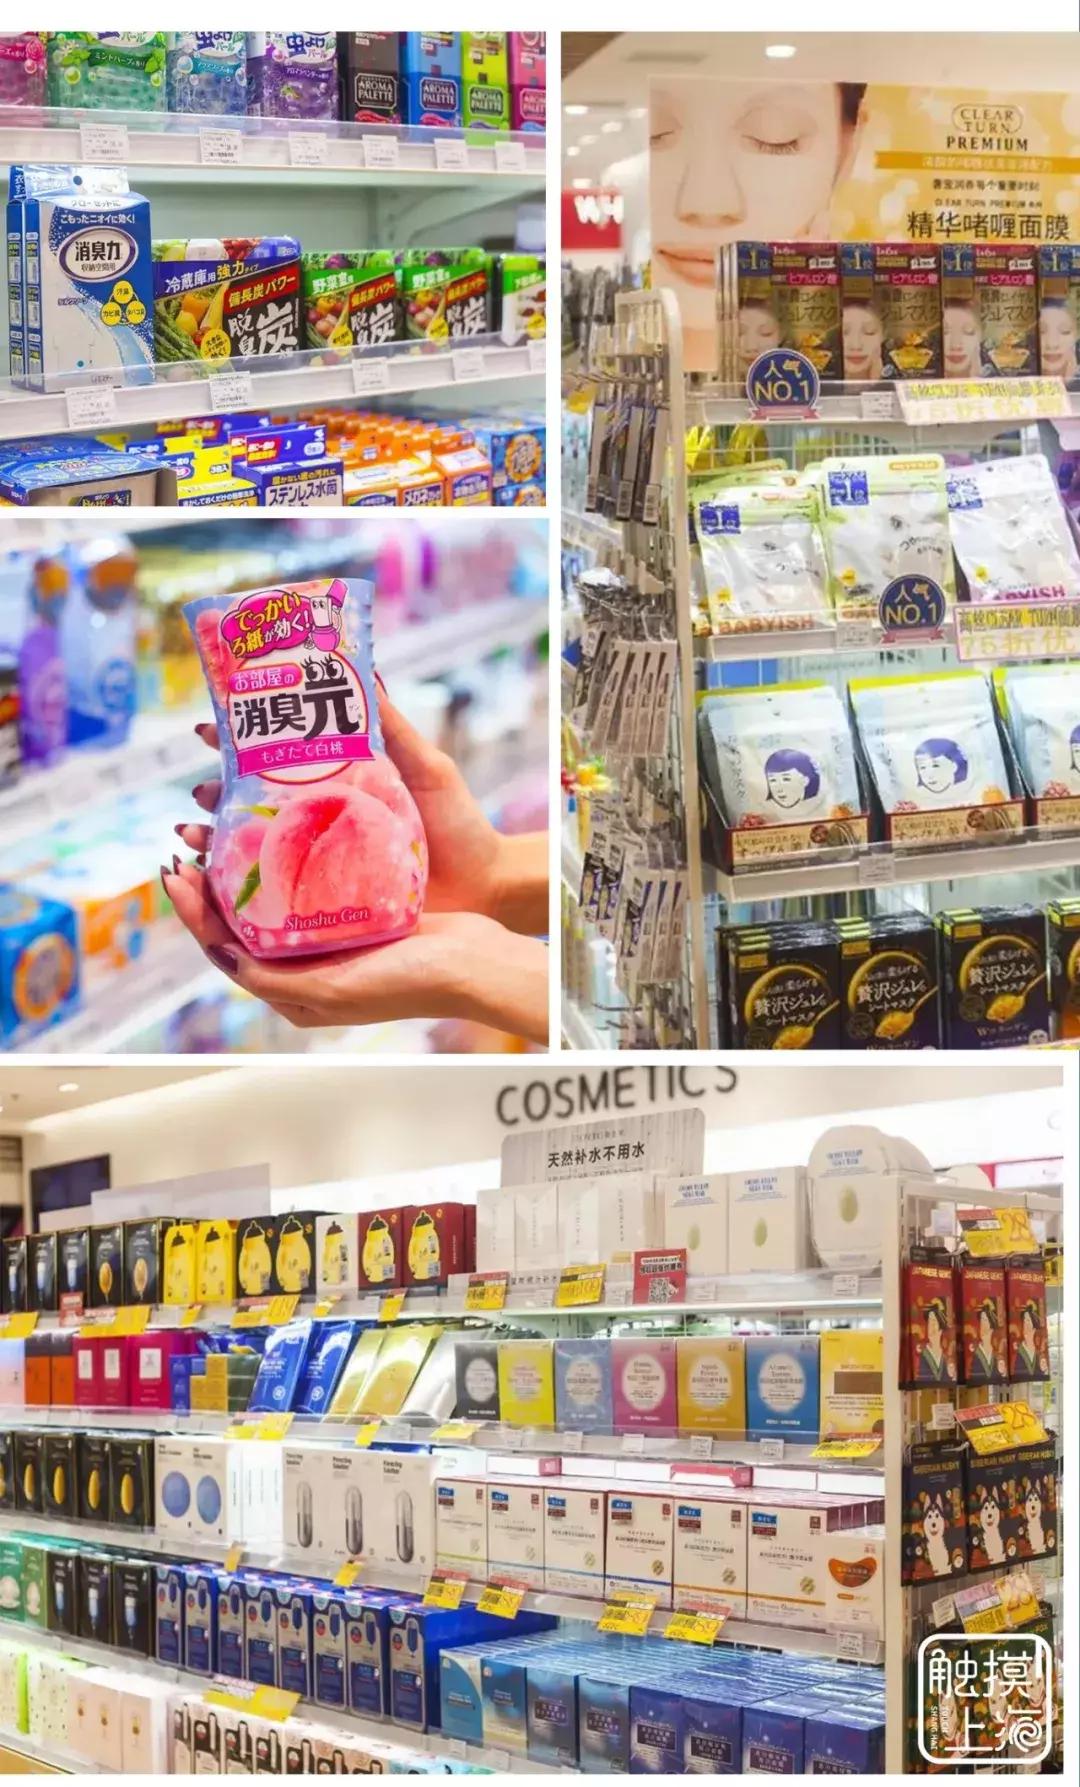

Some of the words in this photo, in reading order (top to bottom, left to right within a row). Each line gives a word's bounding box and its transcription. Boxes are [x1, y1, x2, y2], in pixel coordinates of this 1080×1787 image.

[358, 80, 393, 91] AROMA
[358, 90, 393, 101] PALETTE
[423, 79, 455, 95] AROMA
[471, 90, 502, 102] AROMA
[423, 92, 456, 105] PALETTE
[471, 99, 502, 112] PALETTE
[960, 108, 1014, 121] CLEAR
[964, 121, 1012, 134] TURN
[946, 136, 1028, 152] PREMIUM
[907, 210, 1071, 241] 精华啫喱面膜
[75, 241, 122, 262] 消臭力
[229, 276, 297, 307] 備長炭パワー
[754, 380, 810, 402] NO.1
[234, 591, 301, 631] でっかい
[885, 603, 938, 626] NO.1
[234, 668, 296, 692] お部屋の
[233, 676, 361, 742] 消臭元
[261, 742, 345, 764] もぎたて白桃
[285, 913, 337, 931] Shoshu
[340, 907, 369, 924] Gen
[969, 964, 1034, 986] 贅沢ジュレ
[857, 979, 924, 1004] 贅沢ジュレ
[754, 994, 825, 1019] 贅沢ジュレ
[547, 1142, 646, 1169] 天然补水不用水
[1001, 1404, 1037, 1430] 28
